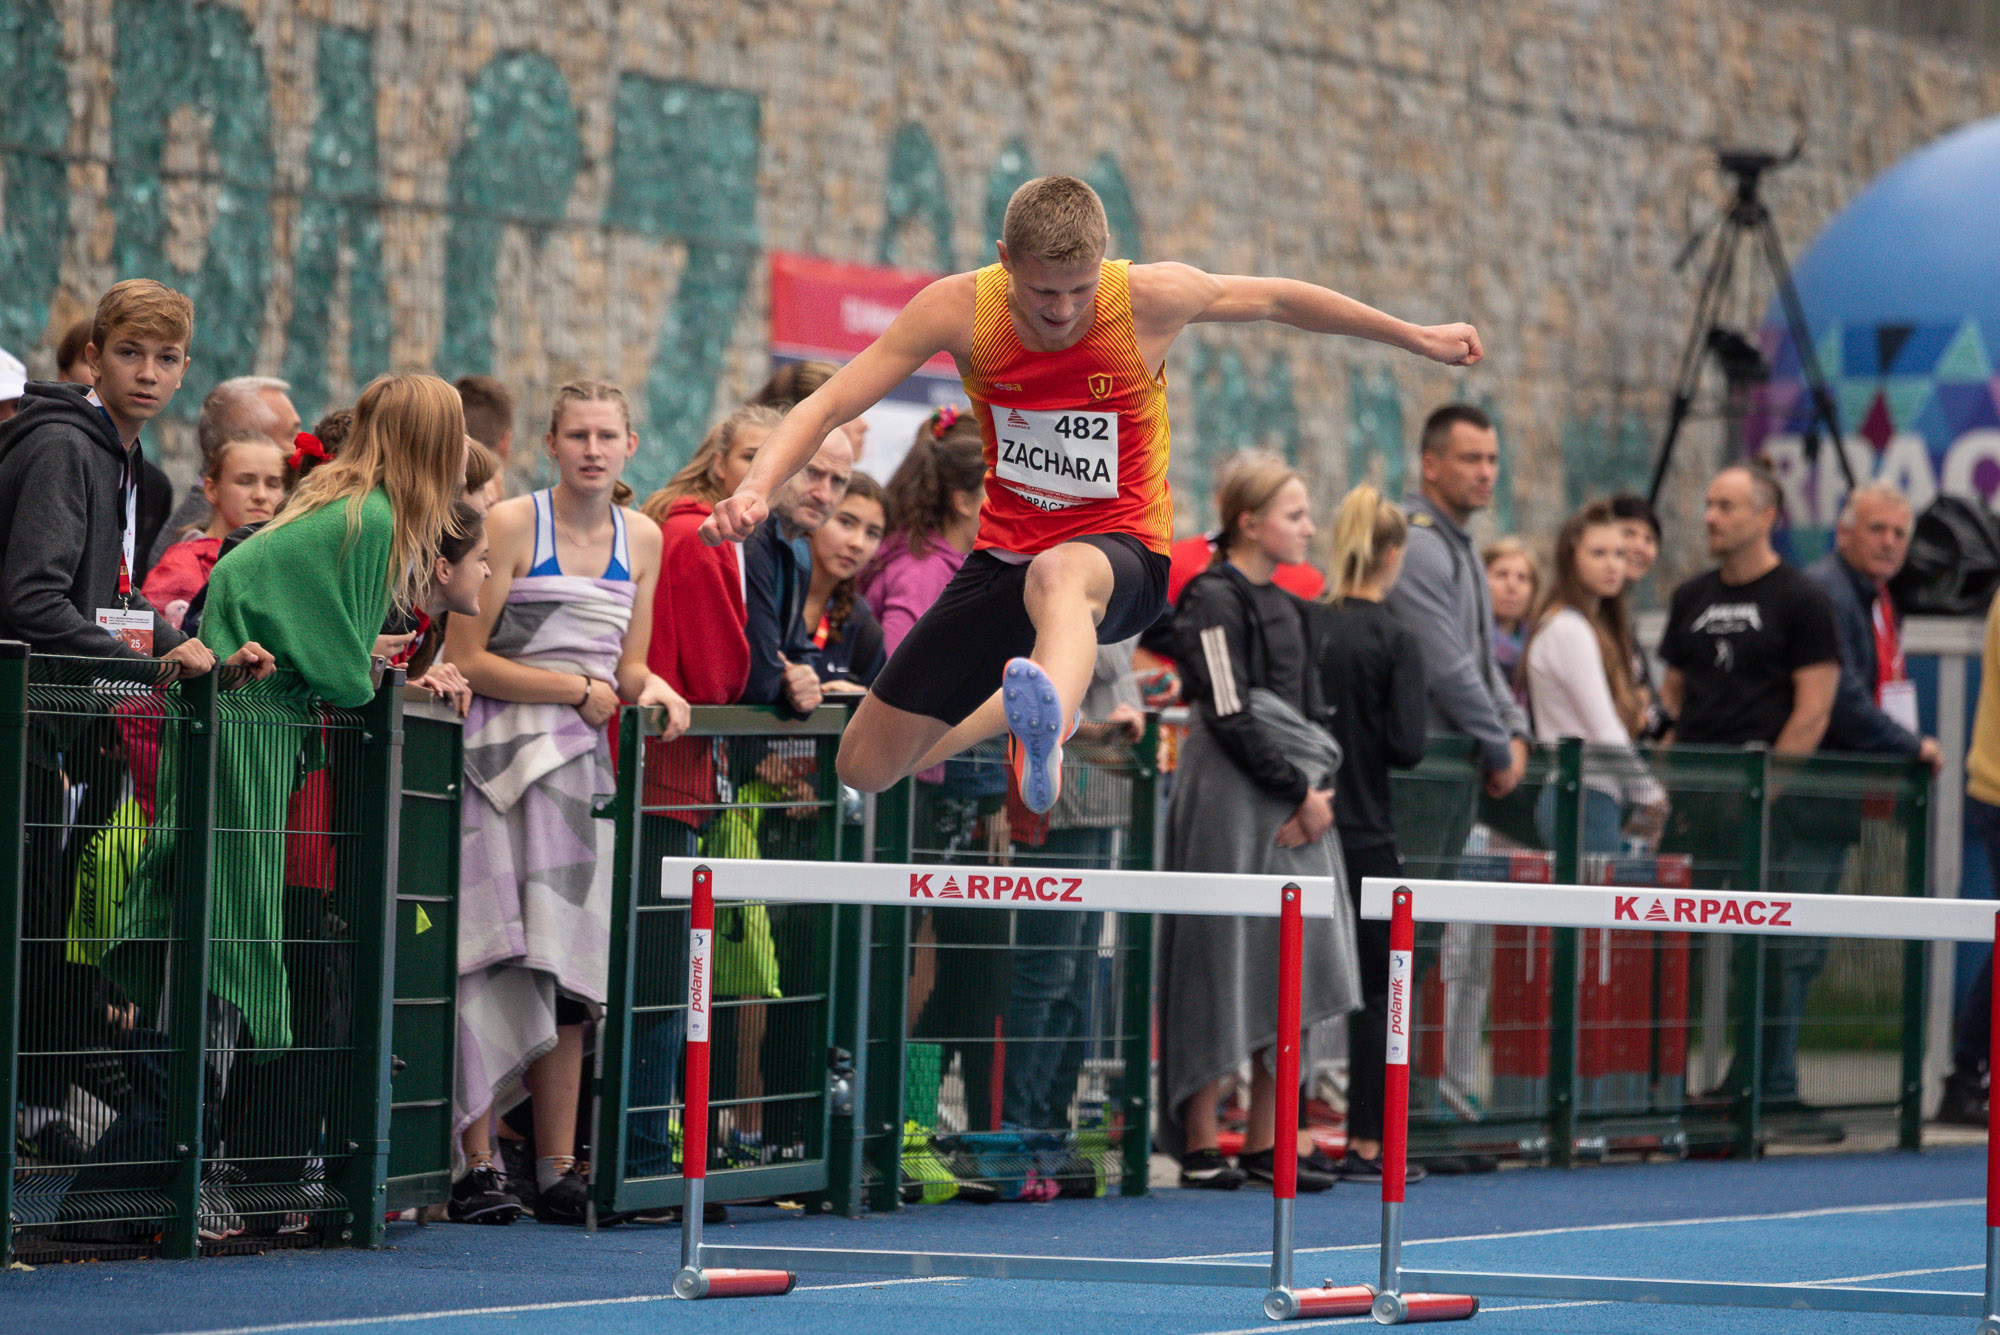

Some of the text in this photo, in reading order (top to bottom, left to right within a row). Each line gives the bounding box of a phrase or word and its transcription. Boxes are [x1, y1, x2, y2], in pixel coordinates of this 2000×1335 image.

[1054, 415, 1109, 440] 482
[1001, 439, 1111, 483] ZACHARA
[130, 638, 141, 649] 25
[909, 873, 1083, 903] KARPACZ
[1614, 895, 1792, 926] KARPACZ
[691, 955, 704, 1013] polanik
[1390, 977, 1404, 1035] polanik
